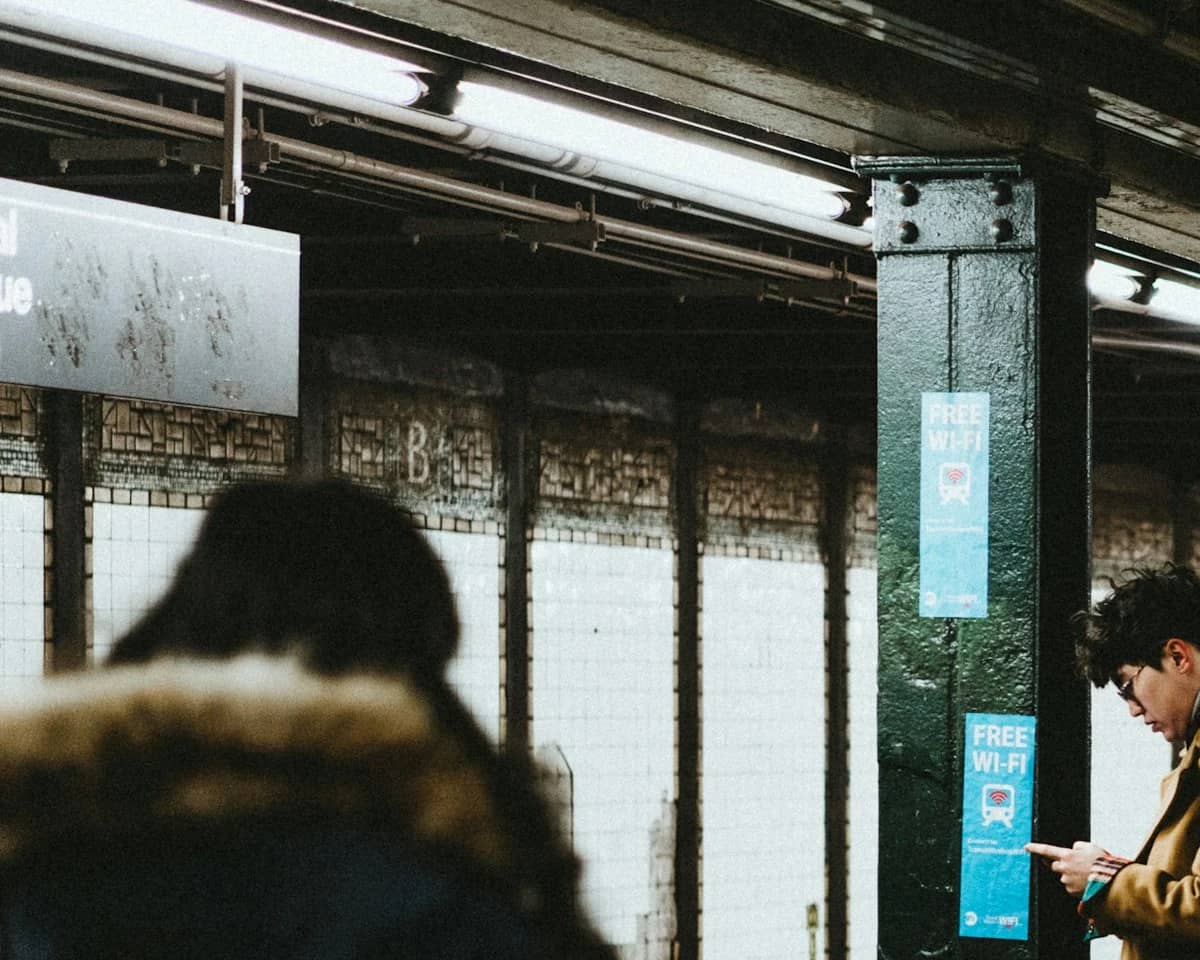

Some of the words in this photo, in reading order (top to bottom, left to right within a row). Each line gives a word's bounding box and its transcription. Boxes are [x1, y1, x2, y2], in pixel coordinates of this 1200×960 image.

[929, 403, 982, 425] FREE
[928, 429, 981, 452] WI-FI
[973, 724, 1028, 748] FREE
[972, 750, 1026, 775] WI-FI
